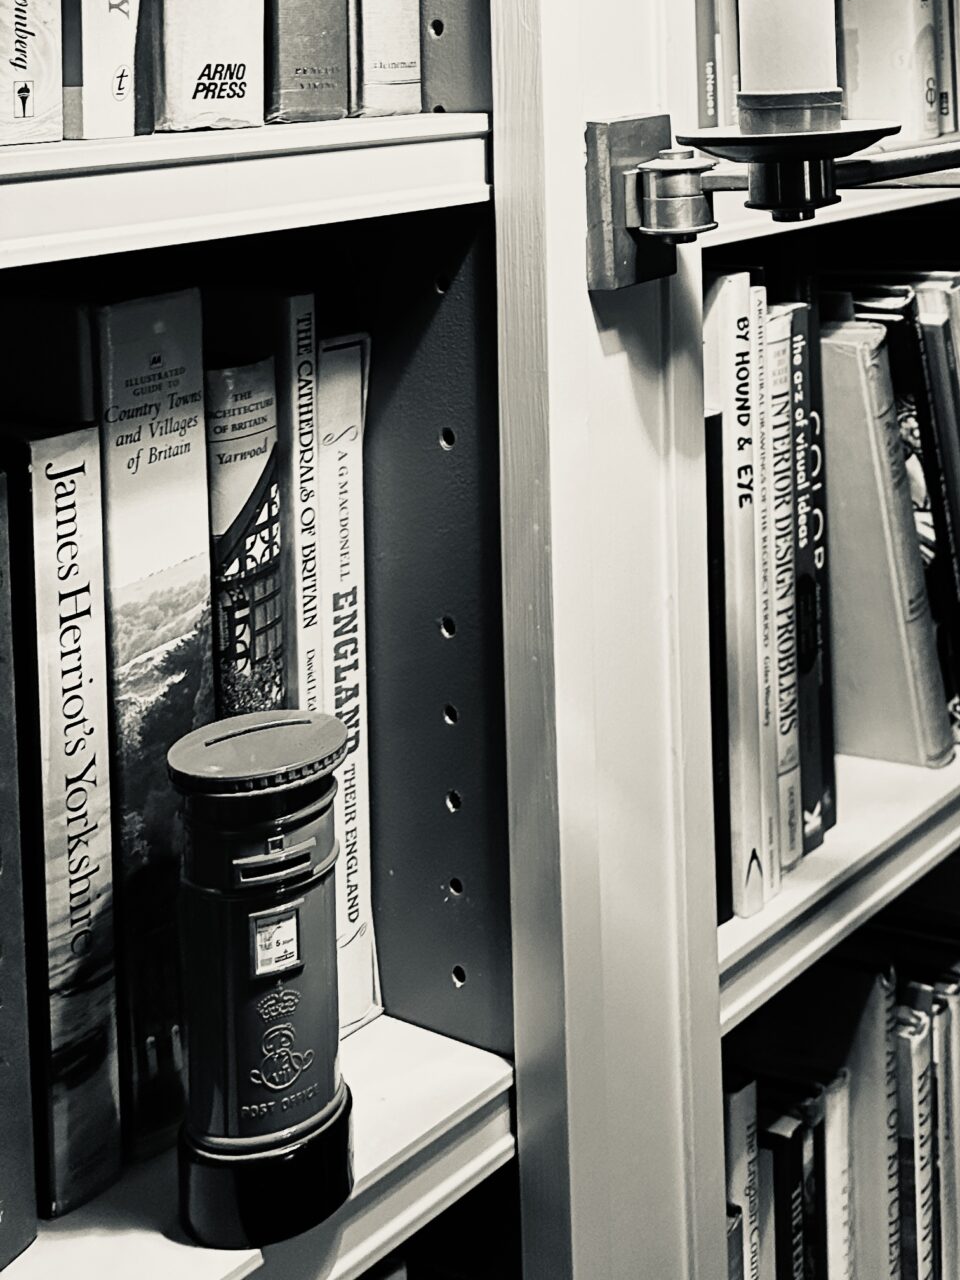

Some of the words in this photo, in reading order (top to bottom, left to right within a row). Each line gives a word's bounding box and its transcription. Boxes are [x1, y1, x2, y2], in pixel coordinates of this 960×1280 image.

[191, 80, 248, 100] PRESS
[197, 62, 247, 82] ARNO
[296, 312, 312, 356] THE
[736, 316, 750, 342] BY
[791, 334, 807, 366] the
[124, 366, 187, 388] ILLUSTRATED
[132, 381, 164, 398] GUIDE
[167, 378, 181, 390] TO
[735, 350, 752, 427] HOUND
[793, 370, 804, 403] a-z
[104, 400, 162, 425] Country
[167, 389, 203, 411] Towns
[213, 423, 229, 436] OF
[230, 414, 269, 433] BRITAIN
[794, 407, 810, 429] of
[115, 422, 142, 448] and
[149, 413, 200, 442] Villages
[215, 436, 269, 466] Yarwood
[296, 359, 316, 504] CATHEDRALS
[737, 436, 753, 451] &
[771, 390, 793, 511] INTERIOR
[127, 447, 144, 475] of
[148, 439, 192, 466] Britain
[796, 432, 812, 491] visual
[738, 464, 754, 509] EYE
[45, 460, 87, 582] James
[300, 506, 317, 537] OF
[774, 514, 796, 601] DESIGN
[301, 541, 320, 631] BRITAIN
[57, 578, 96, 758] Herriot's
[332, 585, 361, 753] ENGLAND
[776, 605, 799, 737] PROBLEMS
[344, 762, 358, 825] THEIR
[63, 753, 100, 958] Yorkshire
[344, 826, 361, 924] ENGLAND
[744, 1155, 759, 1226] English
